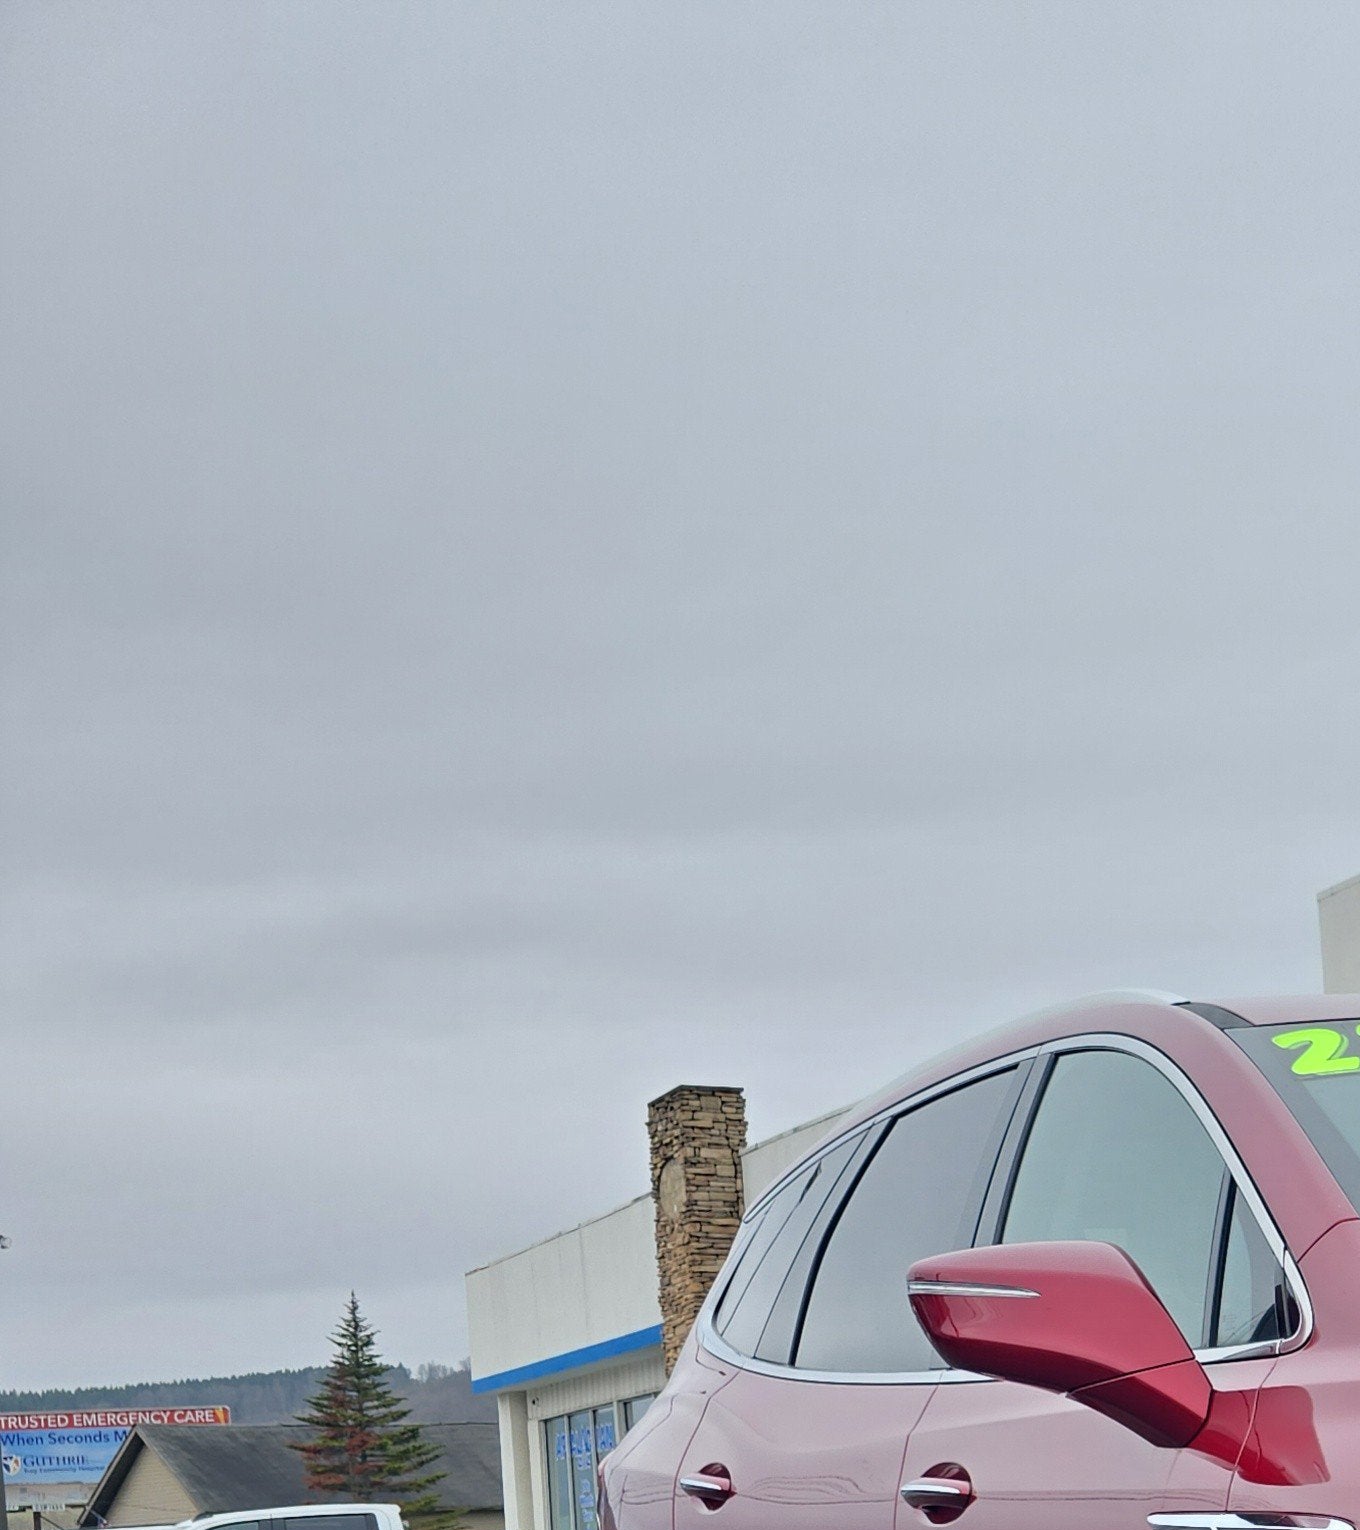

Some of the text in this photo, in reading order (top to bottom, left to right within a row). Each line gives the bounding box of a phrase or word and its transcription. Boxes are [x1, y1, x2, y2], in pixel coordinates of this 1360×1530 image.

[0, 1409, 215, 1430] TRUSTED EMERGENCY CARE
[0, 1432, 44, 1446] When
[48, 1430, 110, 1444] Seconds
